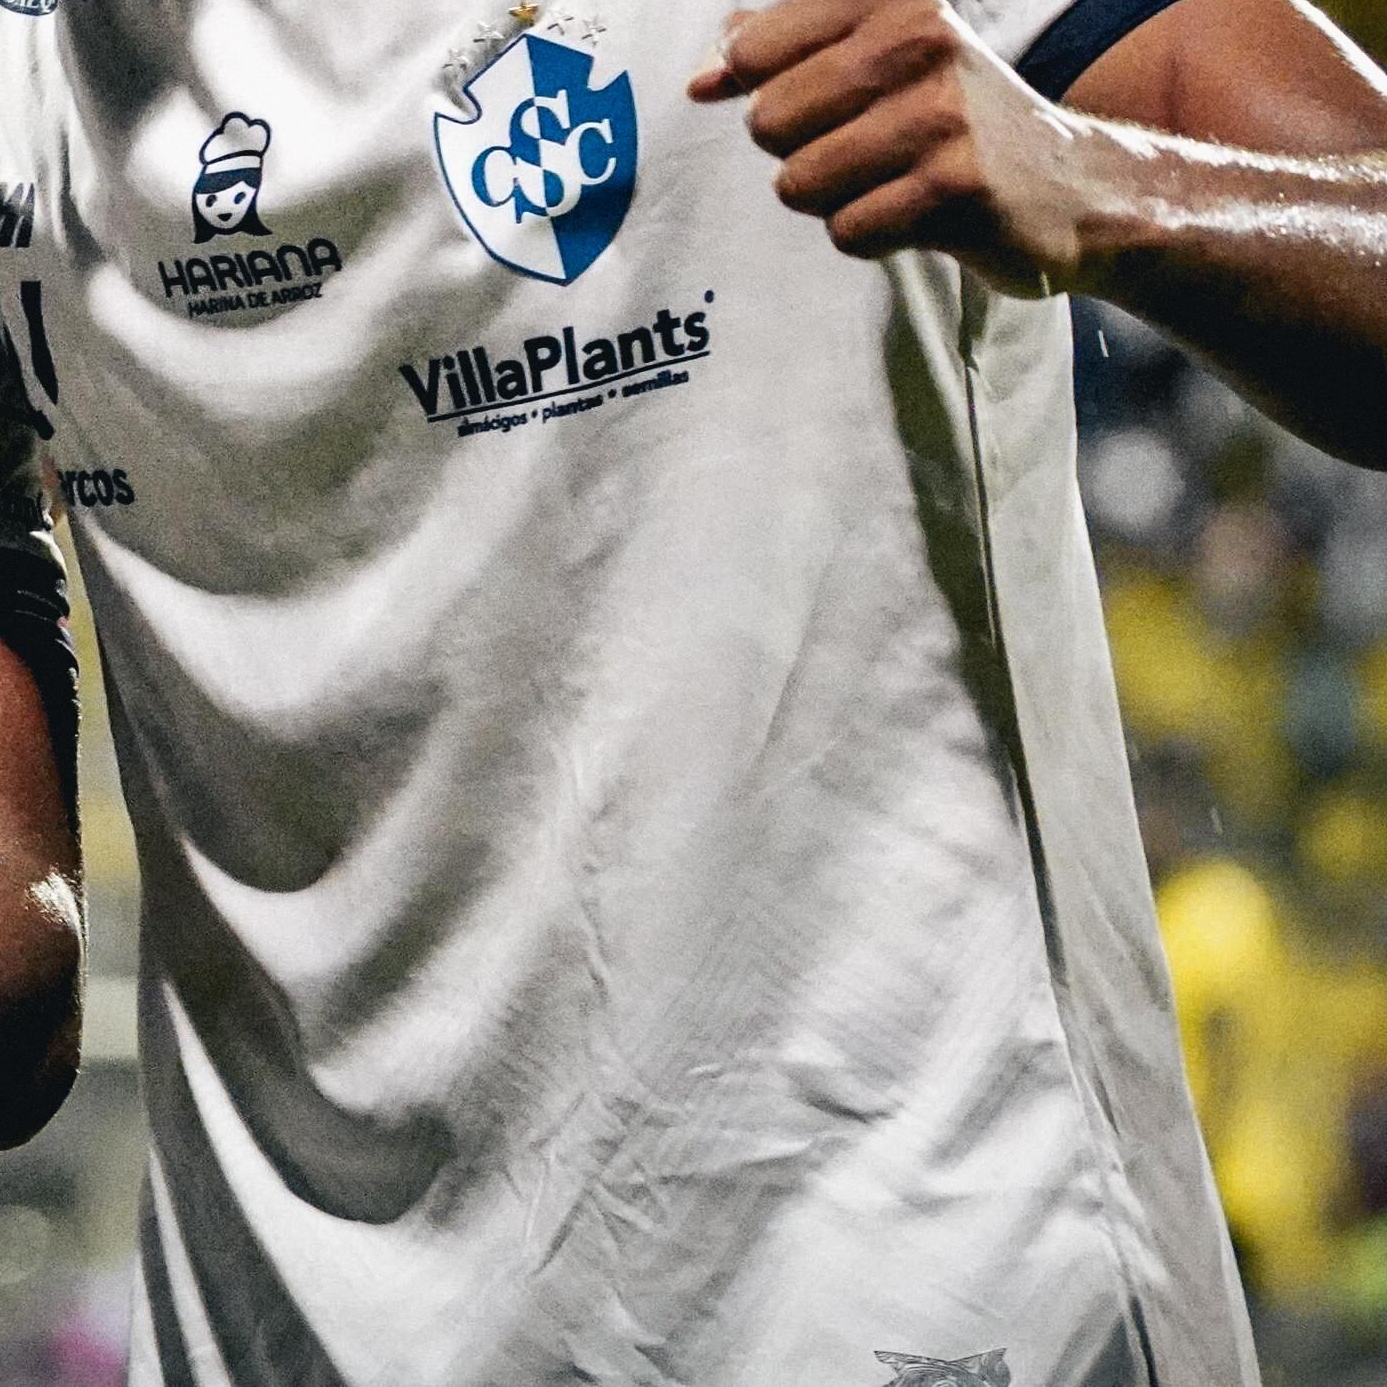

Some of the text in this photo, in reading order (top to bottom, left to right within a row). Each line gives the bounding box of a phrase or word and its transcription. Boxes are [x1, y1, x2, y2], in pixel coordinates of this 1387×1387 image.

[157, 237, 343, 298] HARIANA
[247, 291, 269, 309] DE
[271, 282, 323, 305] ARROZ
[398, 308, 711, 415] VillaPlants
